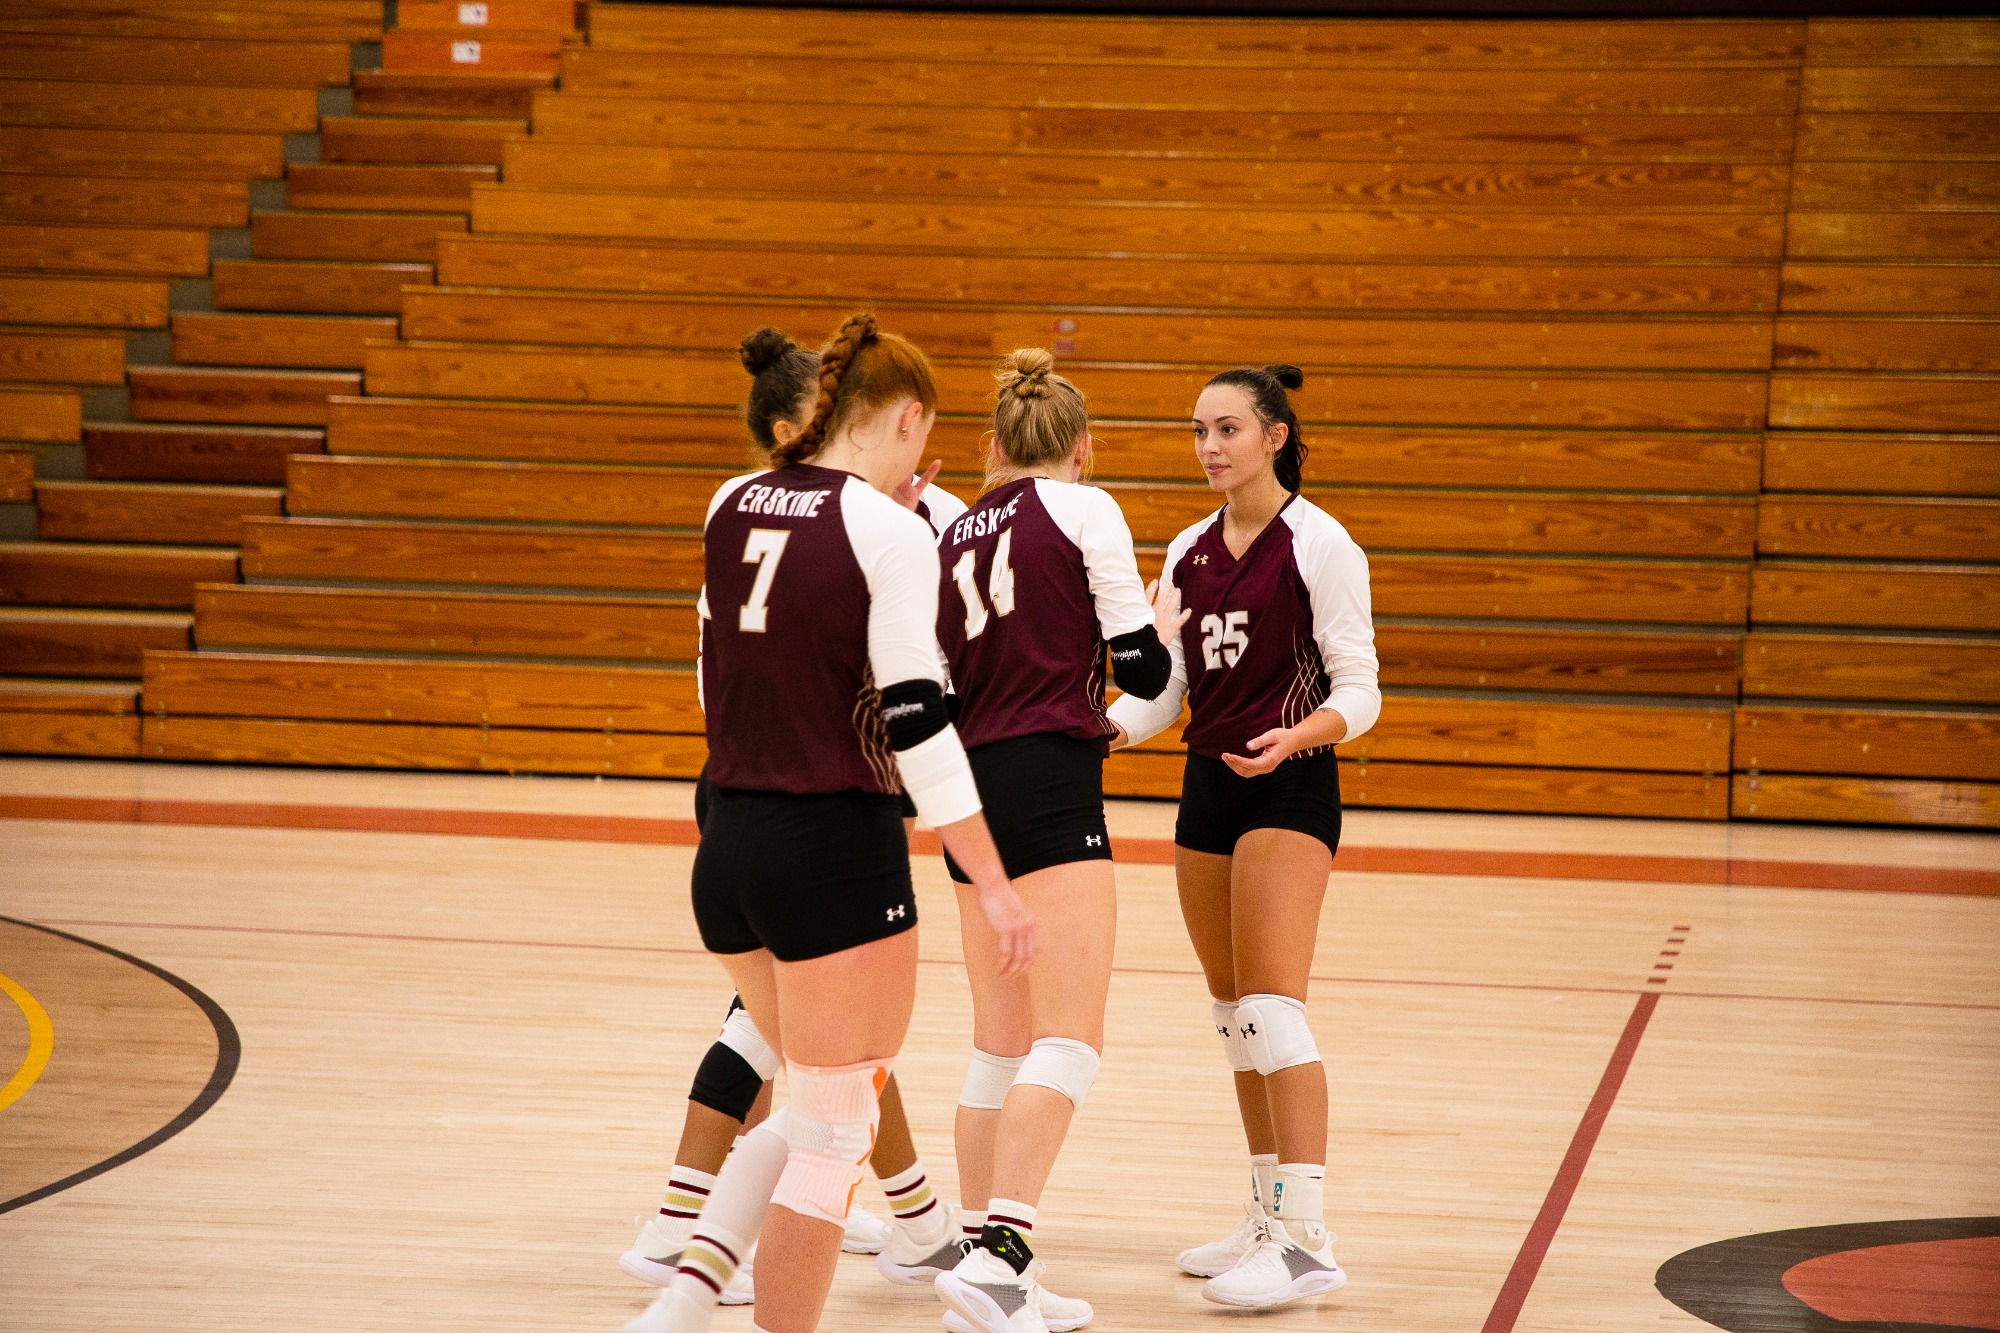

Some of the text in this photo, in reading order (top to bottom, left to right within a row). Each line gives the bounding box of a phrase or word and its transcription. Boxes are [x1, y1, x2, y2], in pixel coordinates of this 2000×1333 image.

[737, 484, 832, 517] ERSKINE
[739, 527, 792, 633] 7
[952, 526, 1015, 641] 14
[1200, 610, 1249, 671] 25
